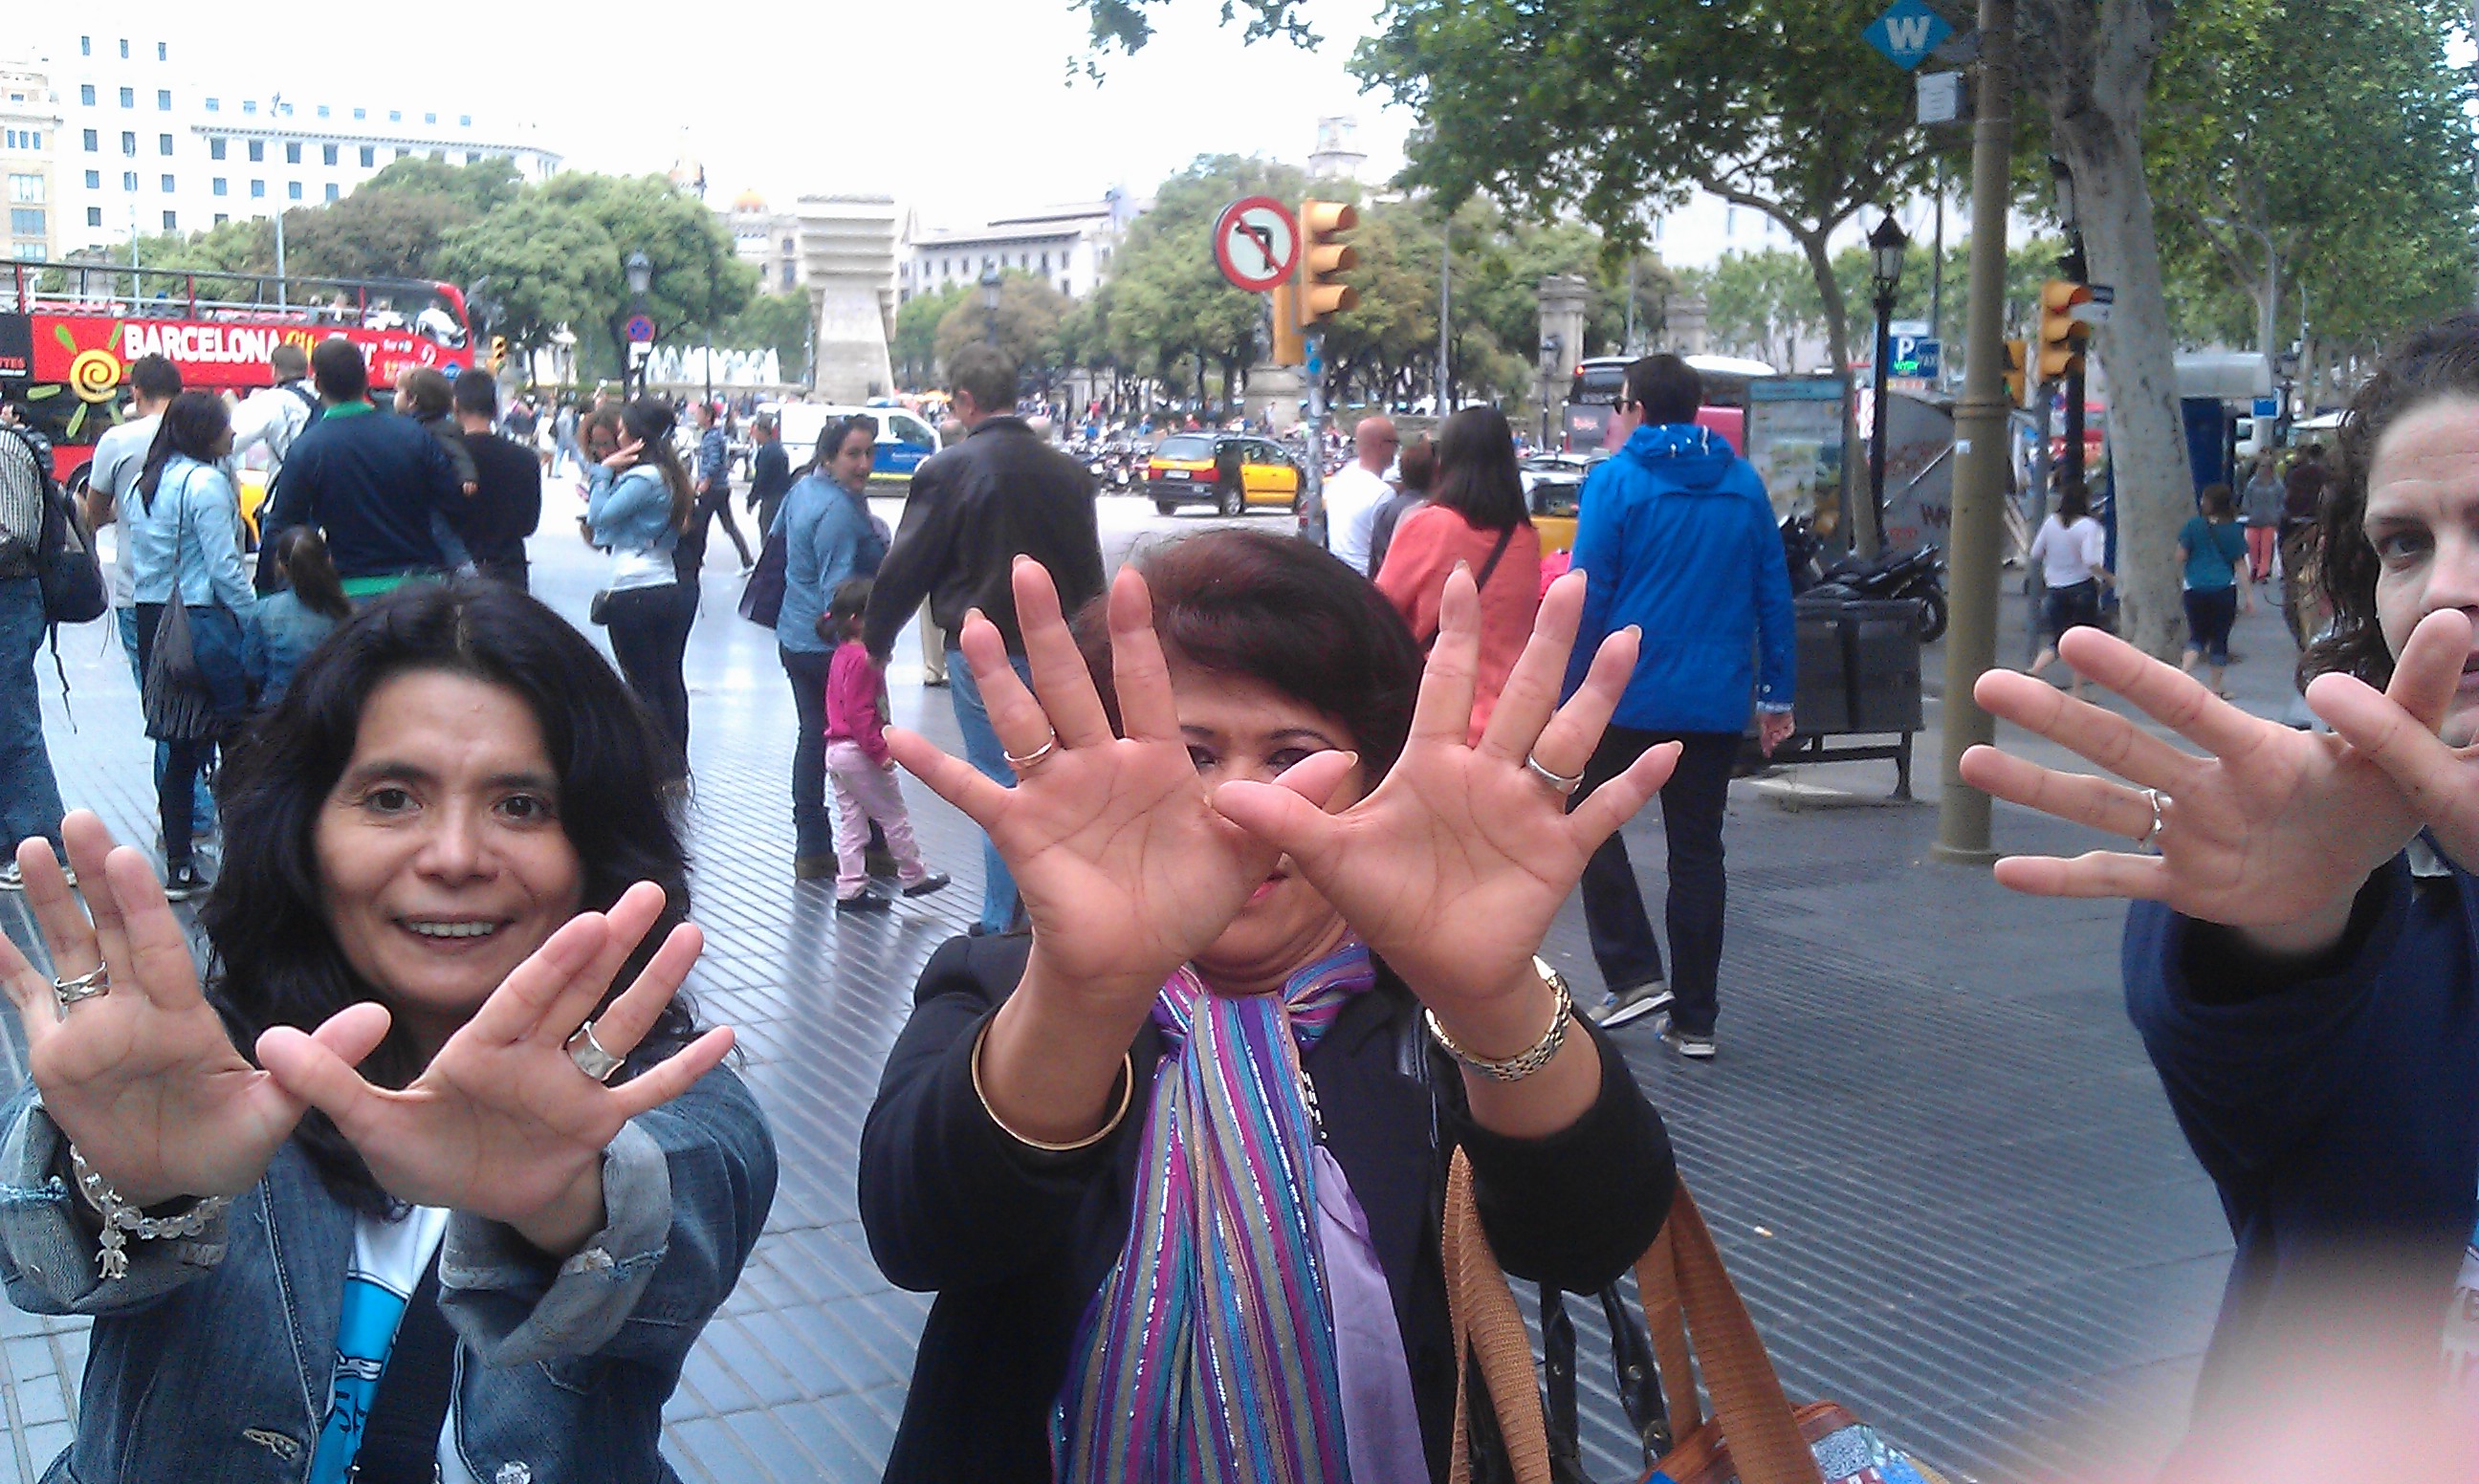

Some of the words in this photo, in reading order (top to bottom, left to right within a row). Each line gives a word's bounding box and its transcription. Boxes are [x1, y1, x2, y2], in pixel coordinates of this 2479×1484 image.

[1885, 15, 1931, 49] W
[124, 323, 281, 364] BARCELONA
[1898, 337, 1915, 361] P
